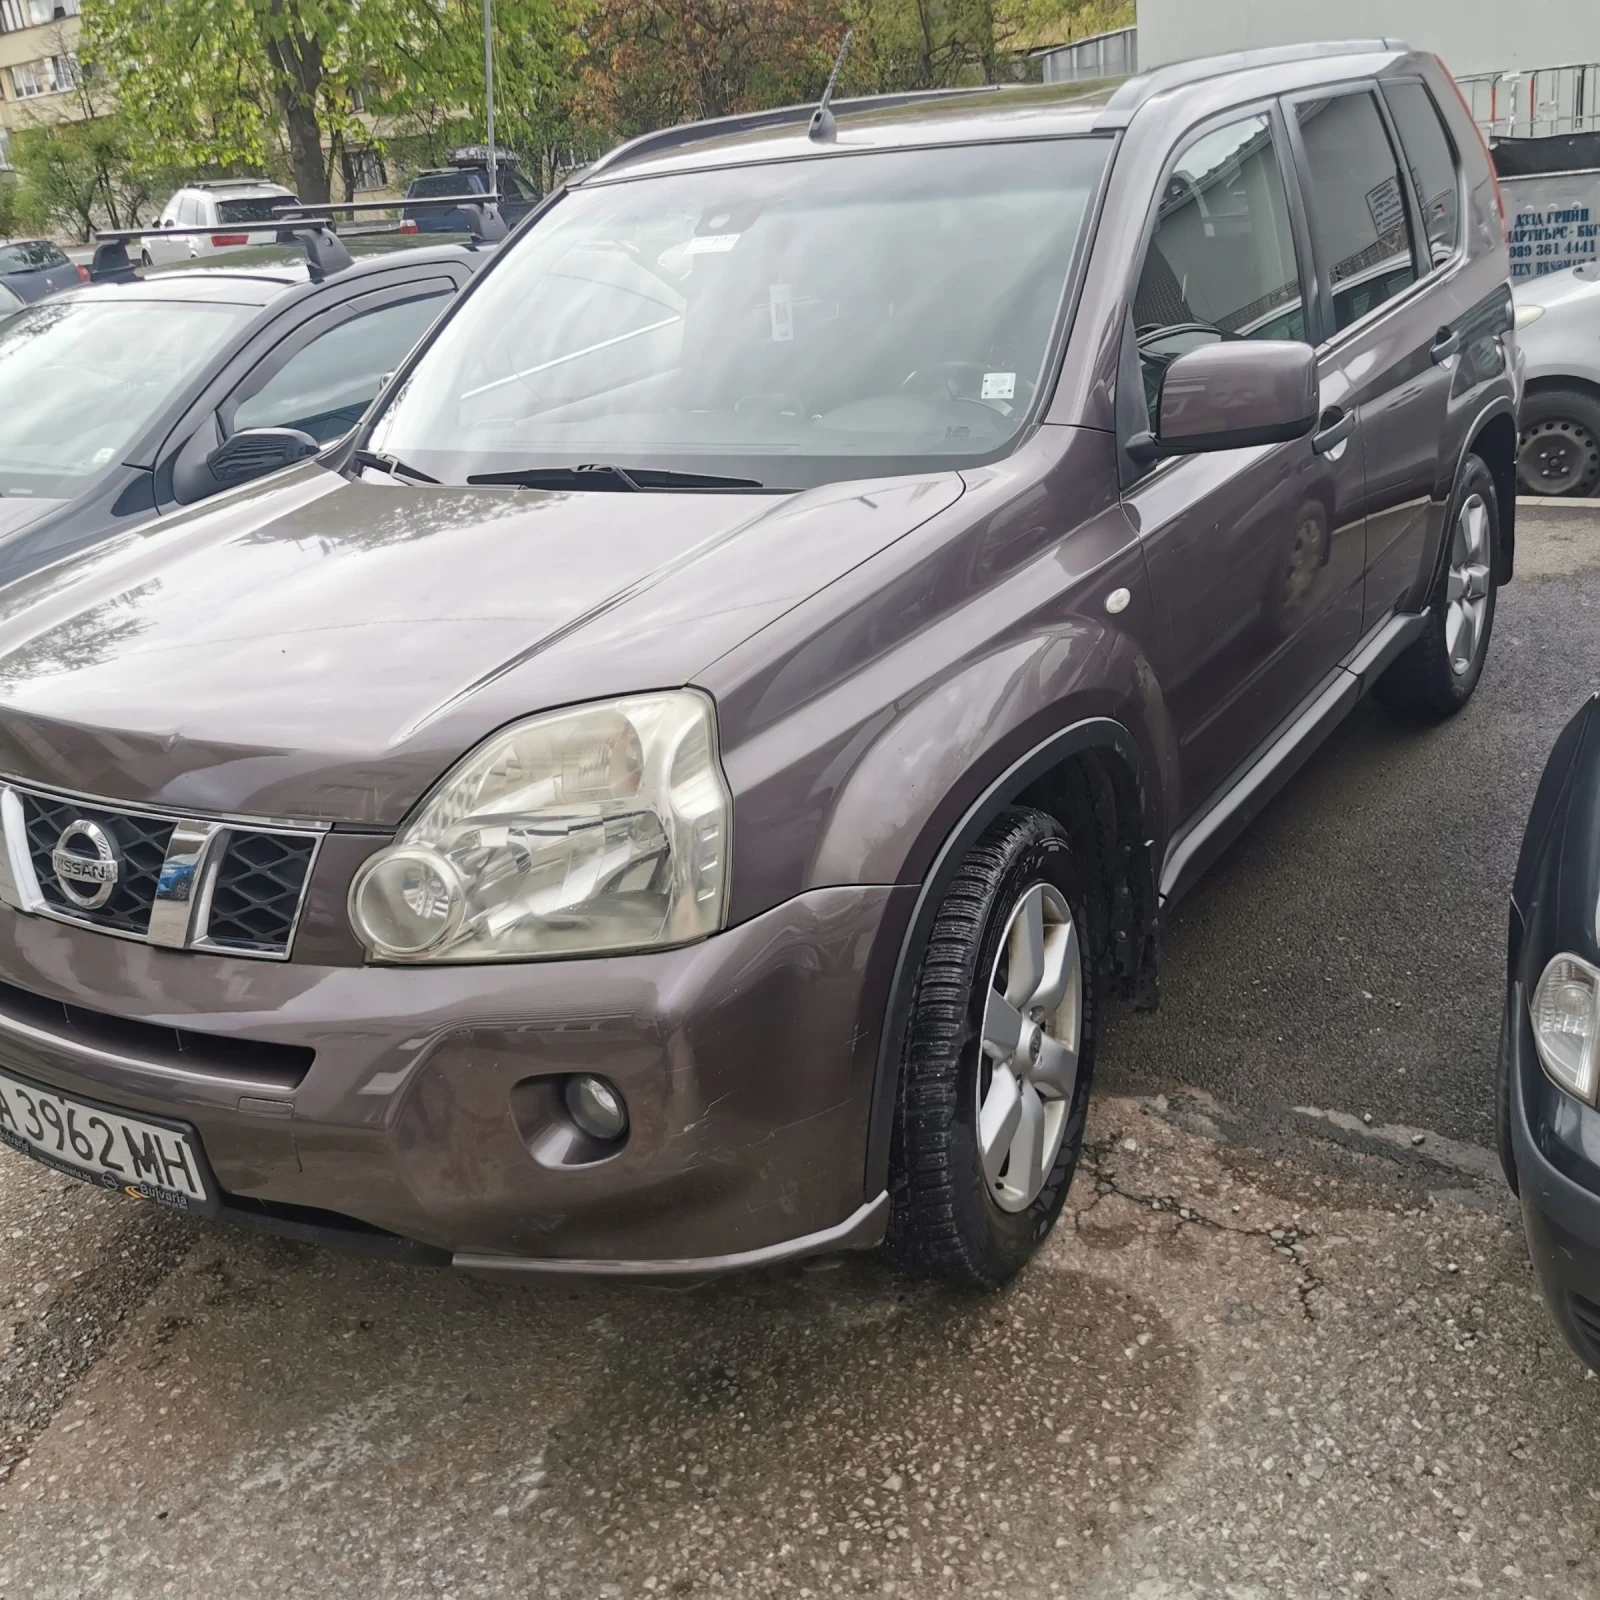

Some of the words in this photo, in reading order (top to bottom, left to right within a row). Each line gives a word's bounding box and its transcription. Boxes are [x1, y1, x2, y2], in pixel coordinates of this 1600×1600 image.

[1509, 246, 1532, 258] 089
[1536, 242, 1559, 256] 361
[1564, 240, 1595, 254] 4441
[54, 854, 105, 879] NISSAN
[140, 1184, 187, 1205] Bulvaria
